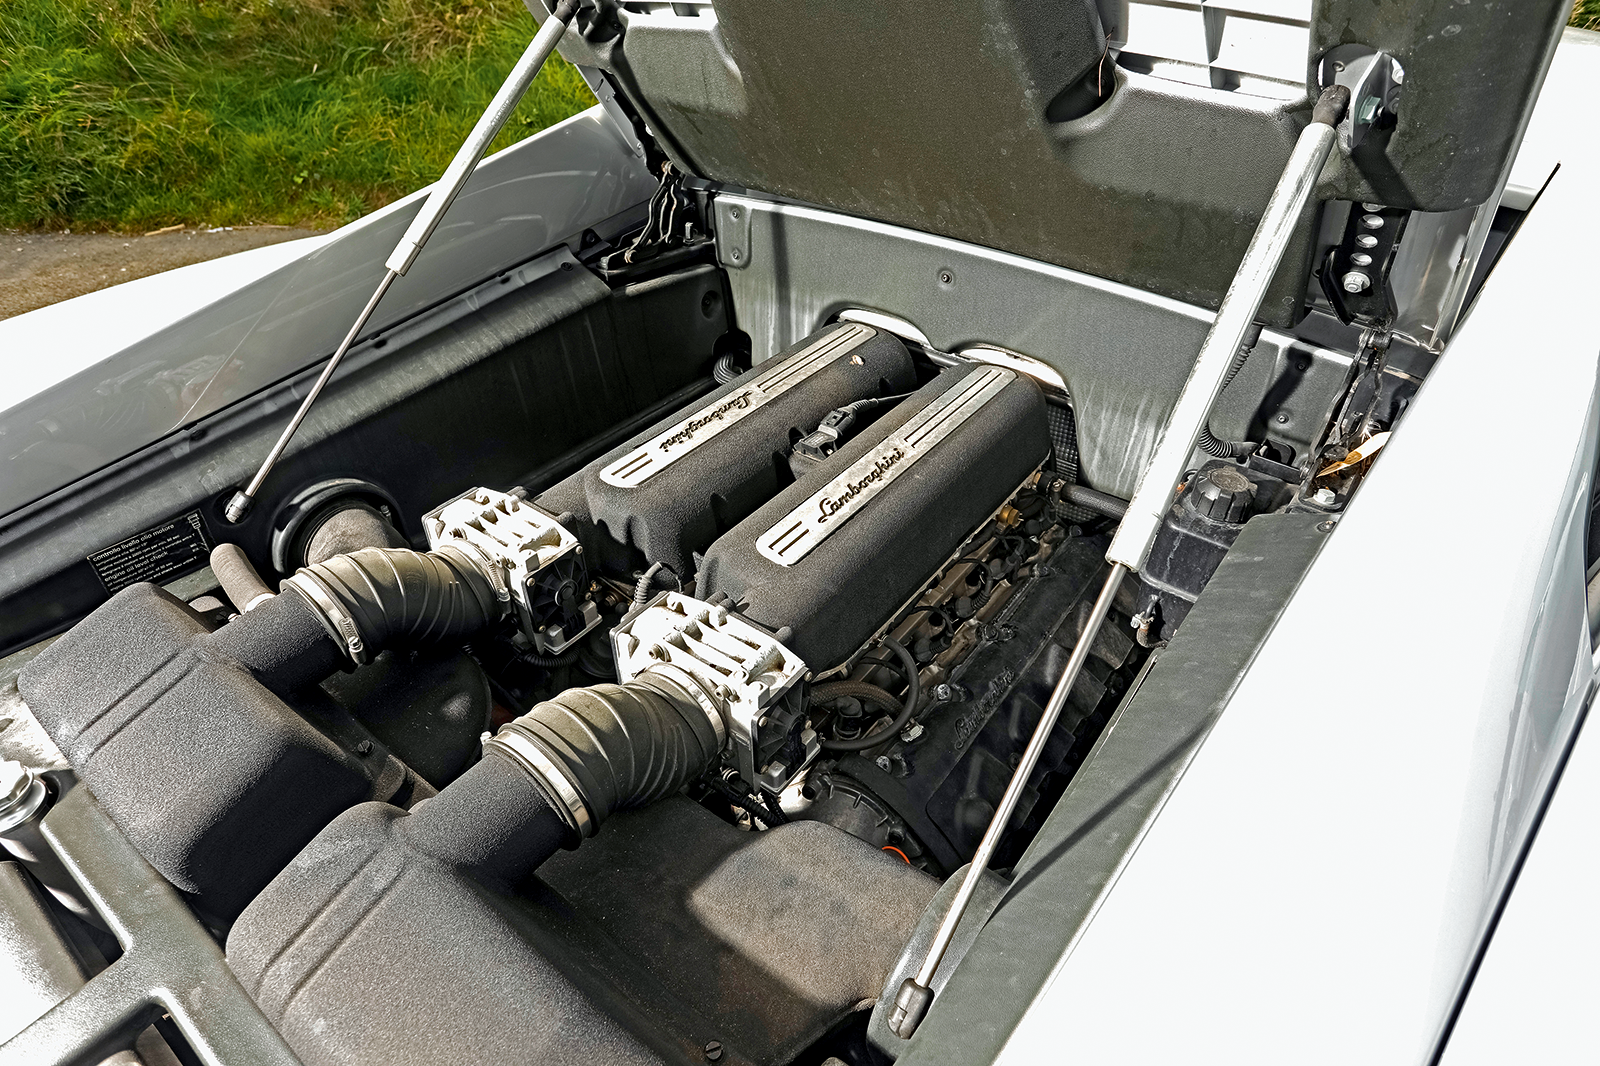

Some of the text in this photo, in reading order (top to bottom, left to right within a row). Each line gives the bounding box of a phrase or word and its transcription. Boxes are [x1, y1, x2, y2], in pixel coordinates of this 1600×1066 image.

[659, 390, 753, 453] Lamborghini
[817, 447, 905, 524] Lamborghini
[92, 547, 121, 562] controllo
[121, 539, 140, 550] livello
[152, 524, 174, 537] motore
[104, 570, 126, 582] engine
[134, 559, 149, 568] level
[150, 551, 168, 562] check
